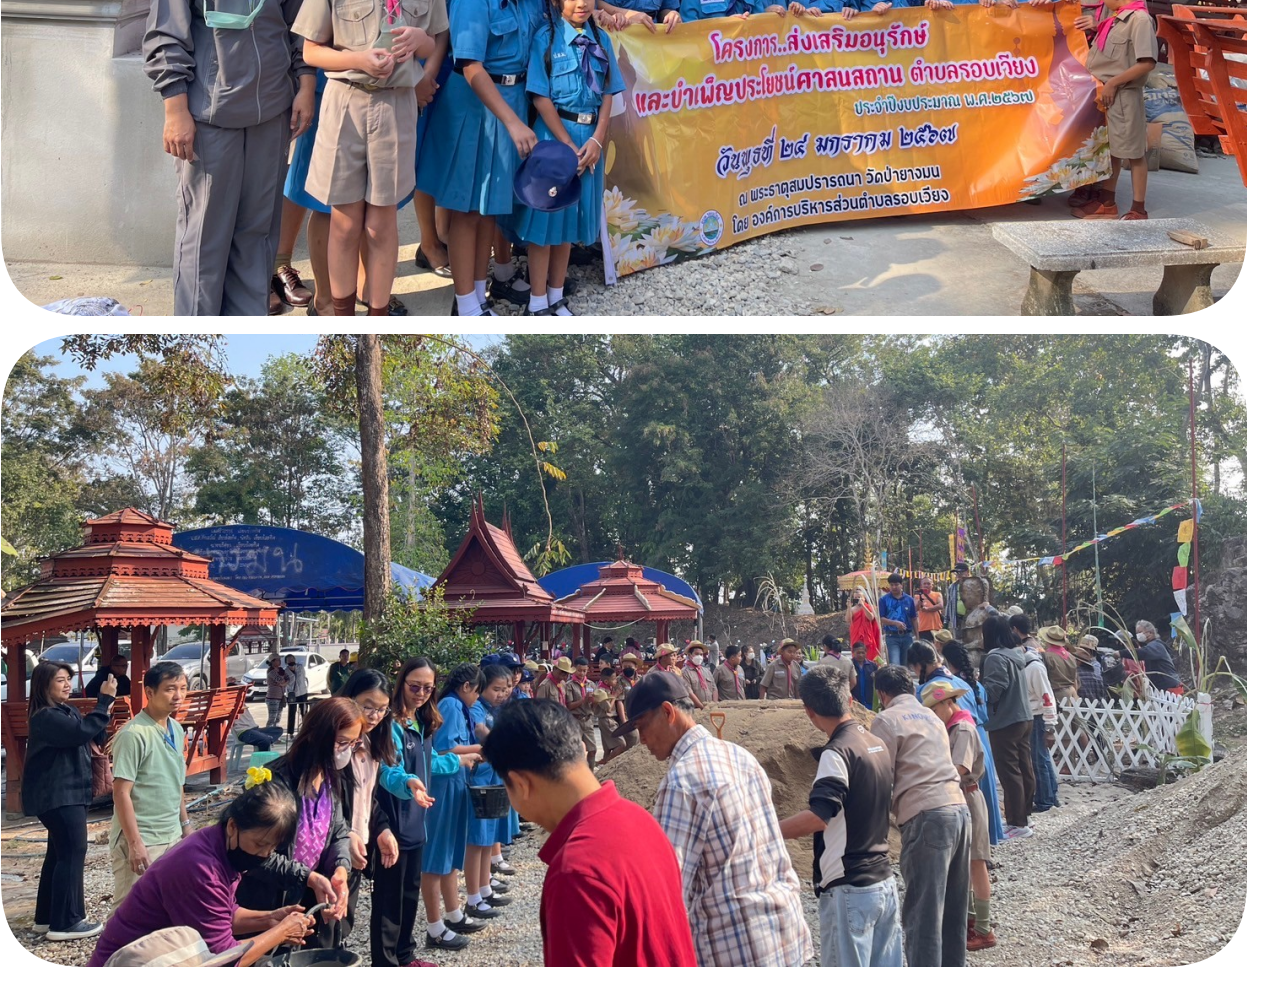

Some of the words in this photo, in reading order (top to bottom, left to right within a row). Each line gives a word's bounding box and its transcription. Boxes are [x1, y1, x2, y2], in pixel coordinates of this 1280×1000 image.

[910, 55, 1037, 84] ตำบลรอบเวียง
[854, 96, 961, 115] ประจำปีงบประมาณ
[739, 193, 748, 207] ณ
[865, 164, 940, 184] วัดป่ายางมน
[733, 216, 749, 233] โดย
[752, 187, 949, 226] องค์การบริหารส่วนตำบลรอบเวียง
